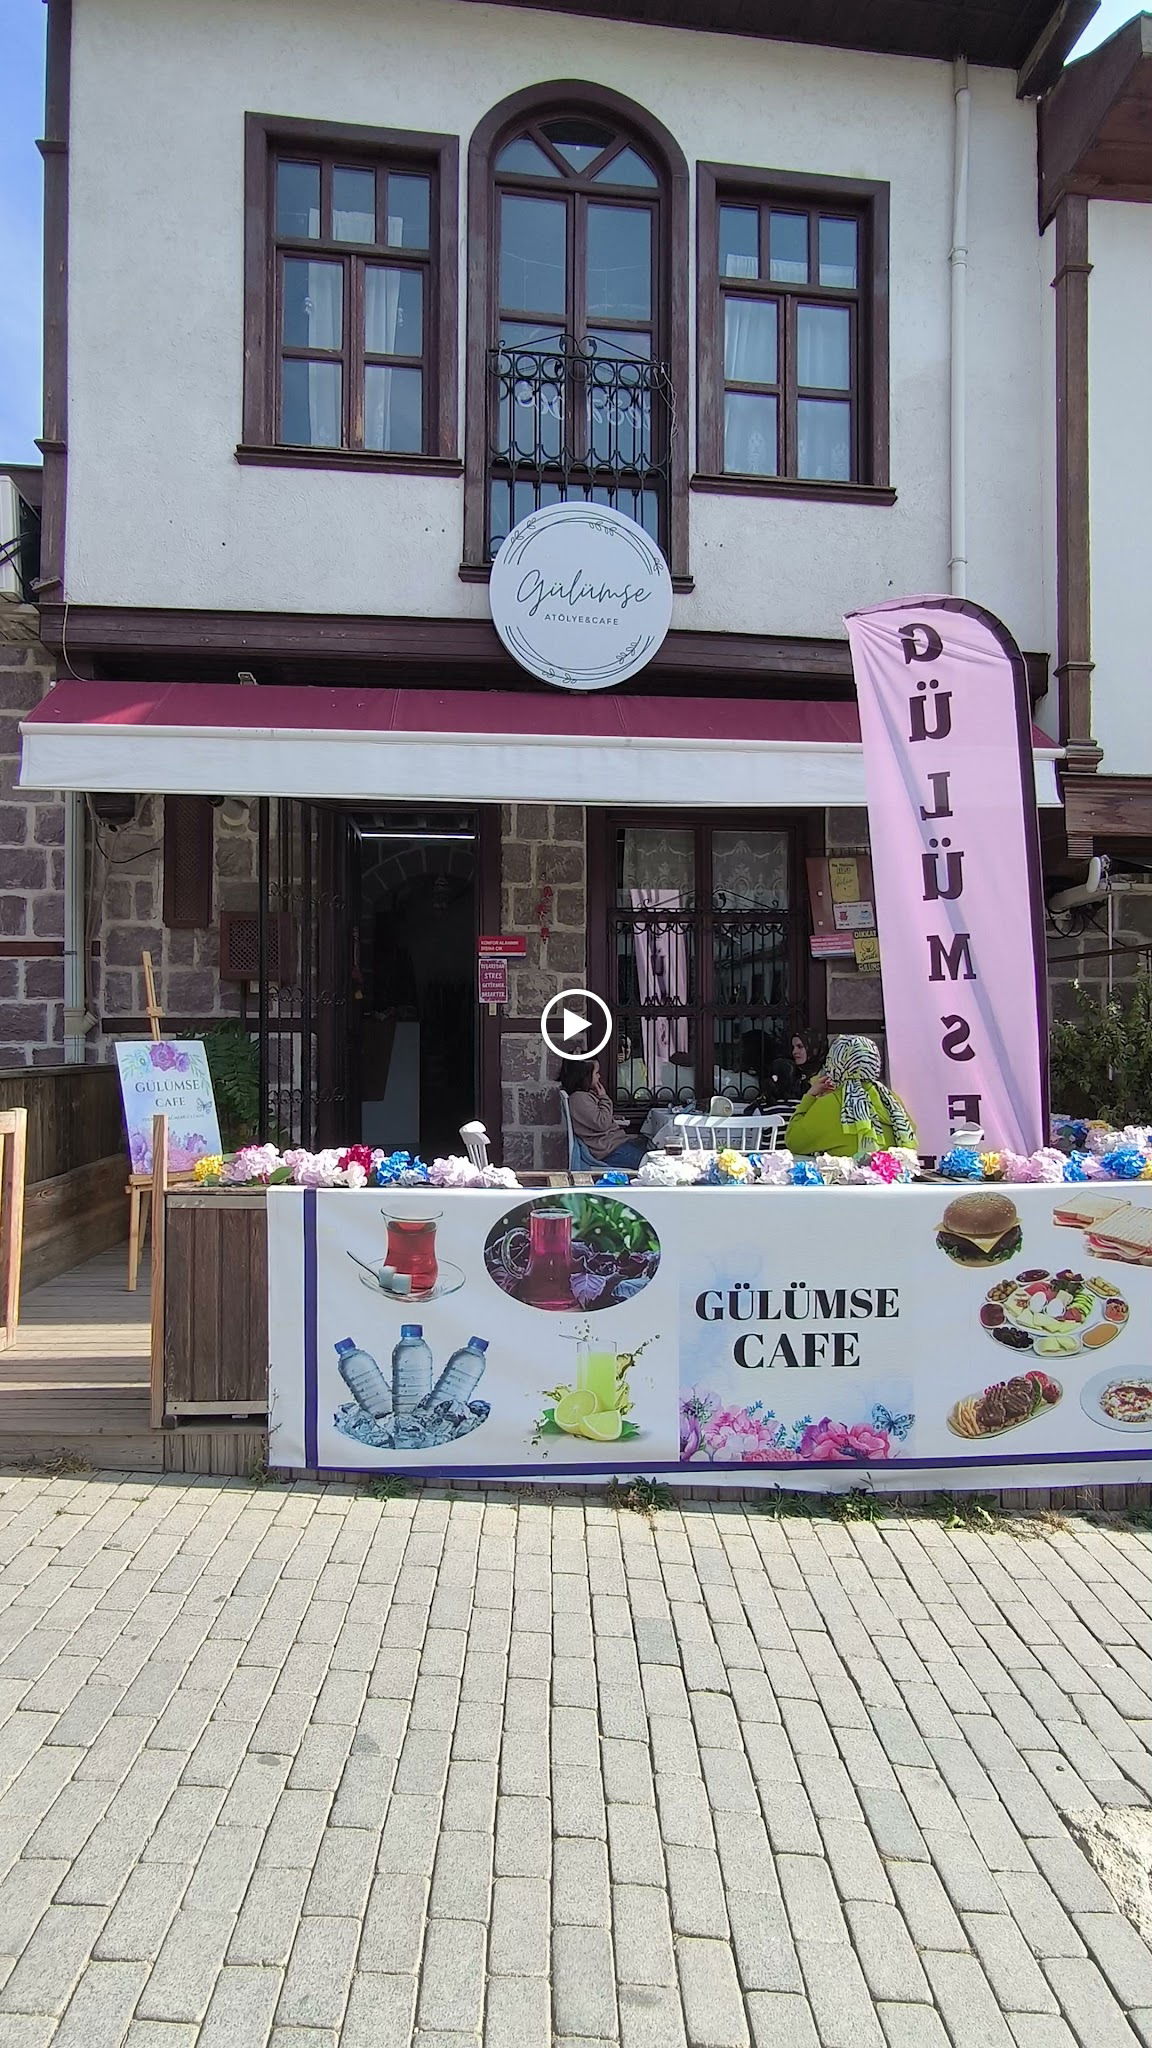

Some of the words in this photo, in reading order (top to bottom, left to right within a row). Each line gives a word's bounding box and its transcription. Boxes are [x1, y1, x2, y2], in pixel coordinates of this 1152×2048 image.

[516, 569, 652, 617] Gülümse
[544, 613, 619, 626] ATÖLYE&CAFE
[155, 1096, 187, 1108] CAFE
[695, 1282, 900, 1321] GÜLÜMSE
[733, 1332, 860, 1369] CAFE
